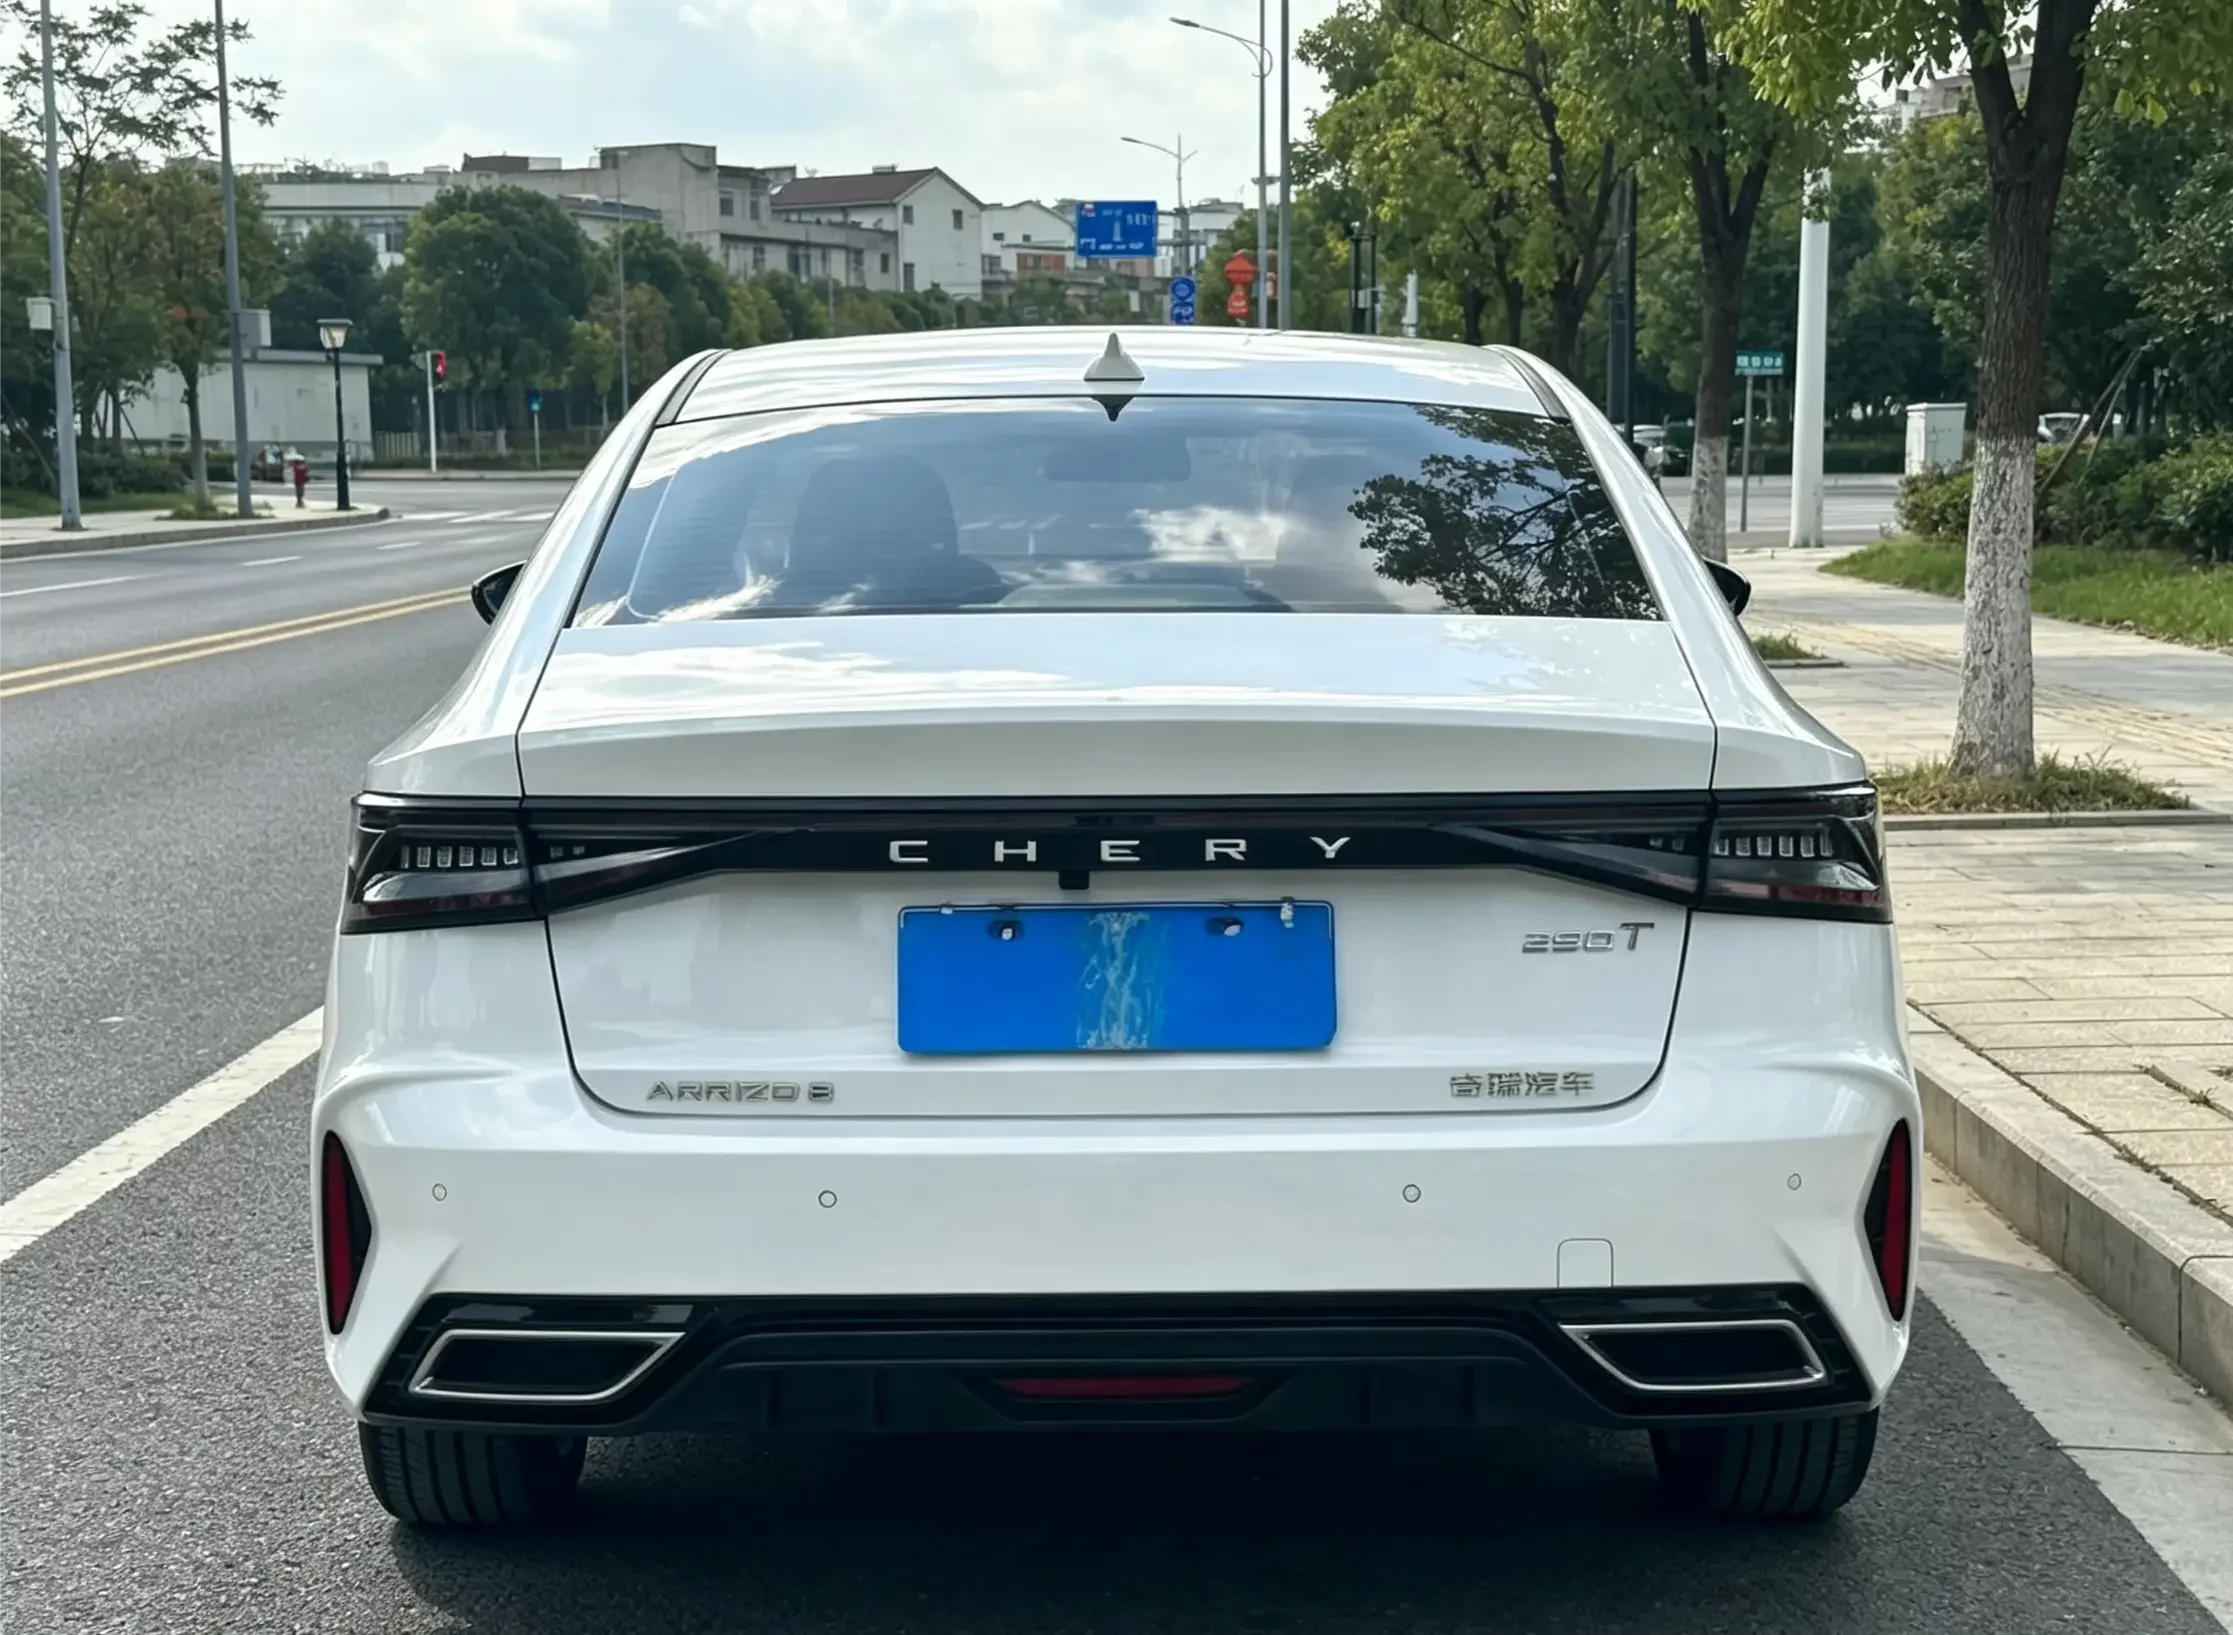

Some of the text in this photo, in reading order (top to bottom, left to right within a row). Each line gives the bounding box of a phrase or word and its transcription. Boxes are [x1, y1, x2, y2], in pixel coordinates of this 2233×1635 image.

[889, 836, 1351, 863] CHERY
[645, 1081, 835, 1102] ARRIZO 8
[1449, 1072, 1595, 1098] 奇瑞汽车
